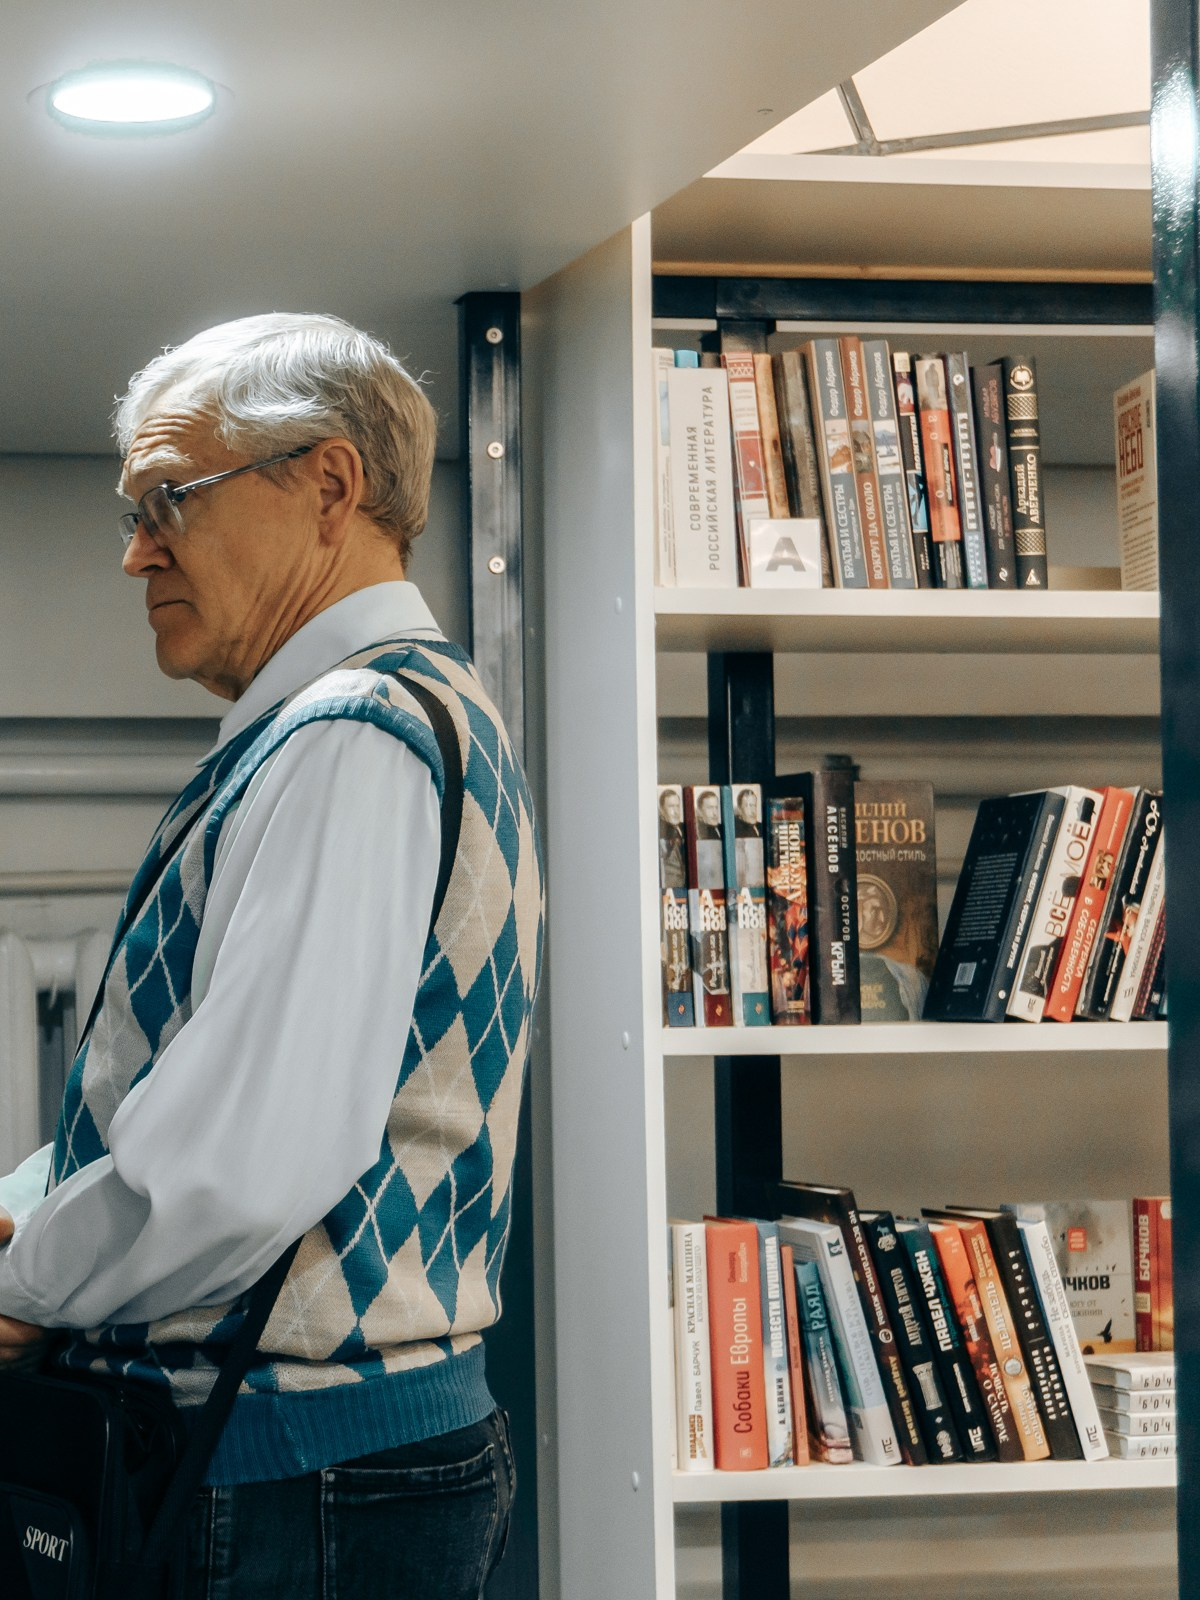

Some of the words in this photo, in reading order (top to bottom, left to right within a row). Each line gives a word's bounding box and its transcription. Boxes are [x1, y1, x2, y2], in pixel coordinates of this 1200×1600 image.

[825, 350, 838, 388] Абрамов
[849, 350, 862, 388] Абрамов
[873, 351, 886, 388] Абрамов
[702, 386, 716, 475] ЛИТЕРАТУРА
[1118, 427, 1144, 478] НЕБО
[686, 425, 701, 532] СОВРЕМЕННАЯ
[863, 481, 878, 519] ОКОЛО
[1015, 463, 1027, 515] Аркадий
[1026, 453, 1040, 524] АВЕРЧЕНКО
[704, 479, 720, 571] РОССИЙСКАЯ
[833, 484, 848, 526] СЕСТРЫ
[882, 484, 897, 526] СЕСТРЫ
[866, 520, 879, 537] ДА
[765, 536, 806, 572] А
[839, 538, 855, 579] БРАТЬЯ
[868, 538, 884, 580] ВОКРУГ
[887, 538, 903, 579] БРАТЬЯ
[839, 807, 847, 849] ВАСИЛИЙ
[856, 819, 926, 844] ЕНОВ
[1059, 822, 1092, 878] МОЁ
[897, 850, 927, 862] СТИЛЬ
[841, 896, 851, 942] ОСТРОВ
[831, 941, 845, 985] КРЫМ
[1060, 909, 1090, 993] СОБСТВЕННОСТЬ
[684, 1232, 694, 1279] МАШИНА
[764, 1235, 781, 1298] ПУШКИНА
[1138, 1214, 1150, 1281] БОЧКОВ
[889, 1267, 908, 1302] БИТОВ
[914, 1250, 940, 1297] ЧЖАН
[686, 1282, 696, 1334] КРАСНАЯ
[767, 1299, 785, 1359] ПОВЕСТИ
[805, 1284, 827, 1332] РАЯД
[871, 1293, 886, 1327] живы
[898, 1301, 923, 1346] АНДРЕЙ
[928, 1298, 953, 1351] ПАВЕЛ
[985, 1281, 1011, 1350] ЦЕЛИТЕЛЬ
[730, 1297, 753, 1365] Европы
[693, 1341, 701, 1376] БАРЧУК
[694, 1380, 702, 1411] Павел
[733, 1371, 753, 1434] Собаки
[776, 1377, 786, 1414] БЕЛКИН
[889, 1355, 906, 1399] Андрей
[902, 1396, 919, 1445] Бильжо
[983, 1380, 992, 1390] О
[989, 1362, 1009, 1413] ПОВЕСТЬ
[778, 1417, 786, 1426] А.
[22, 1525, 69, 1562] SPORT
